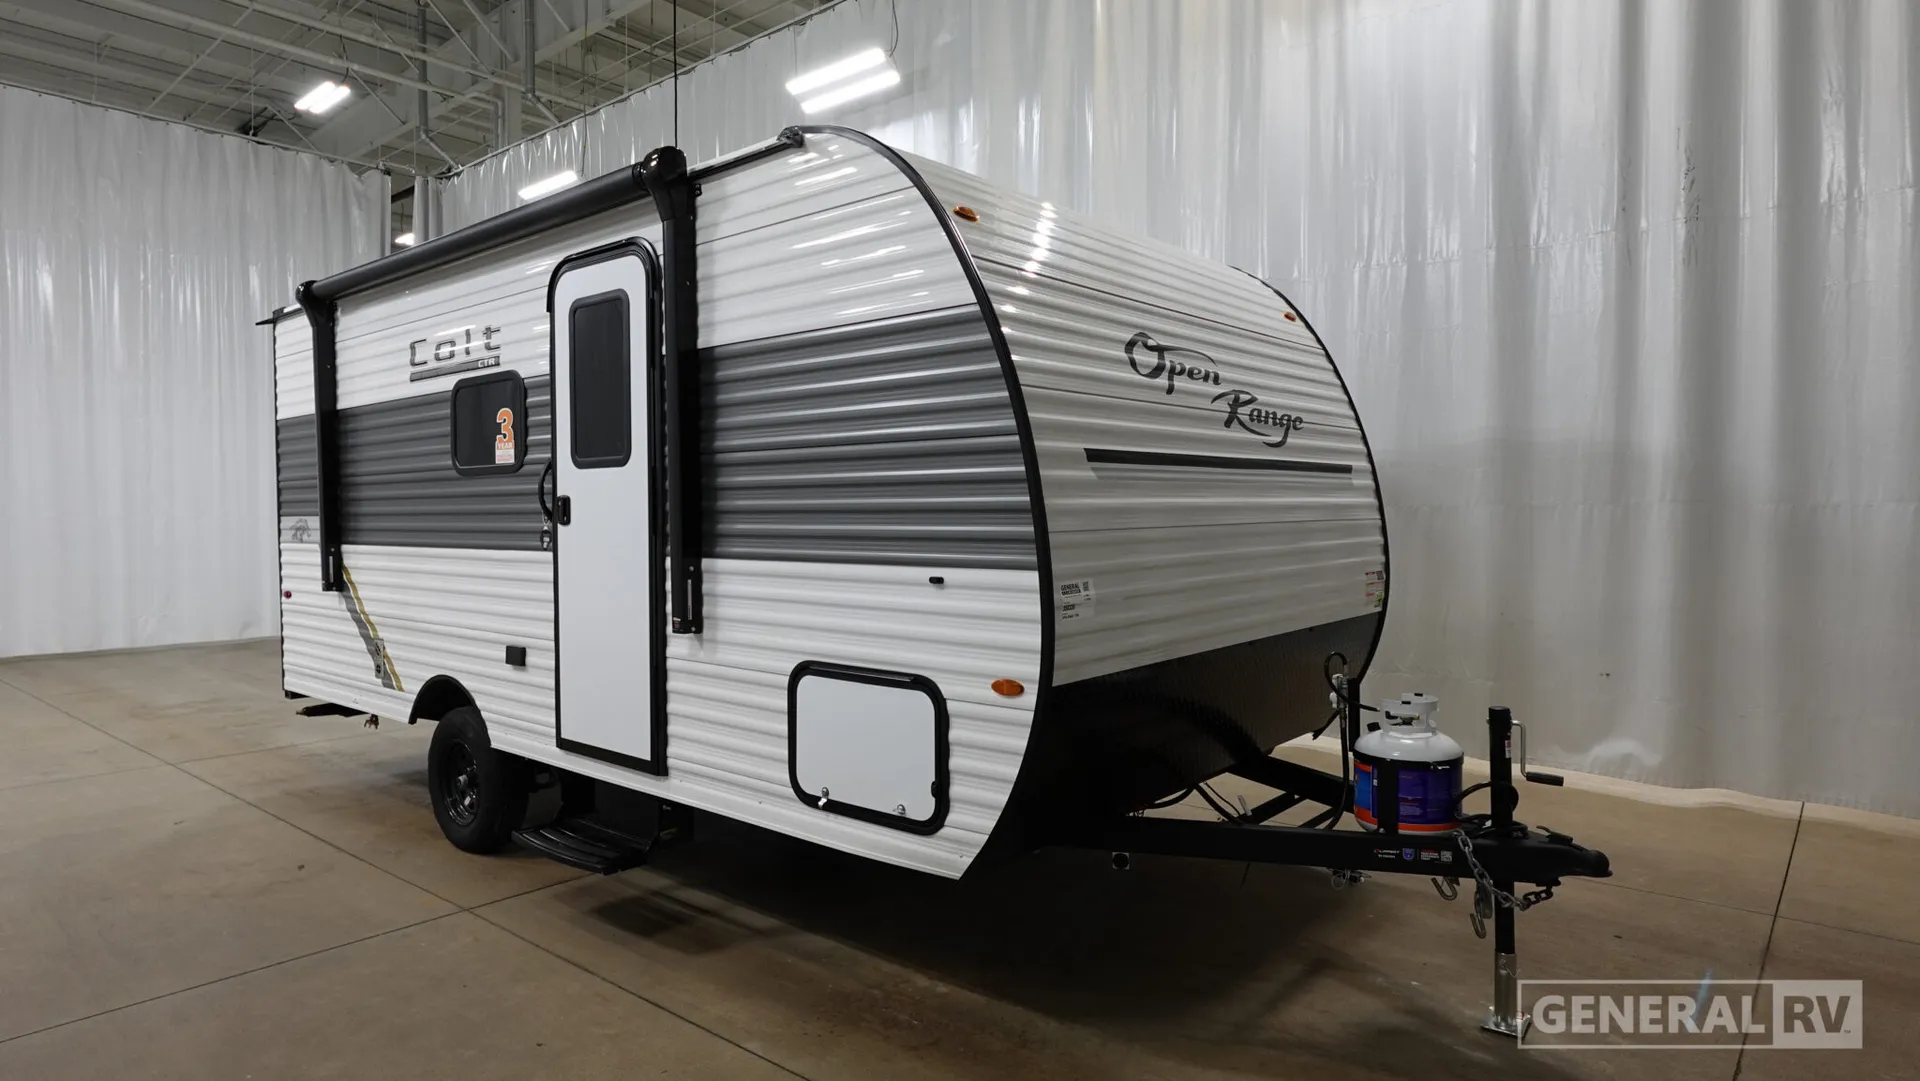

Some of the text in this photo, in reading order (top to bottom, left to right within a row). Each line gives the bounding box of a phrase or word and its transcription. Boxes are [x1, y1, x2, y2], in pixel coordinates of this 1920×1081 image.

[410, 326, 500, 366] Colt
[477, 357, 496, 368] CTR
[1124, 332, 1222, 395] Open
[496, 408, 514, 443] 3
[1211, 389, 1304, 448] Range
[497, 442, 514, 450] YEAR
